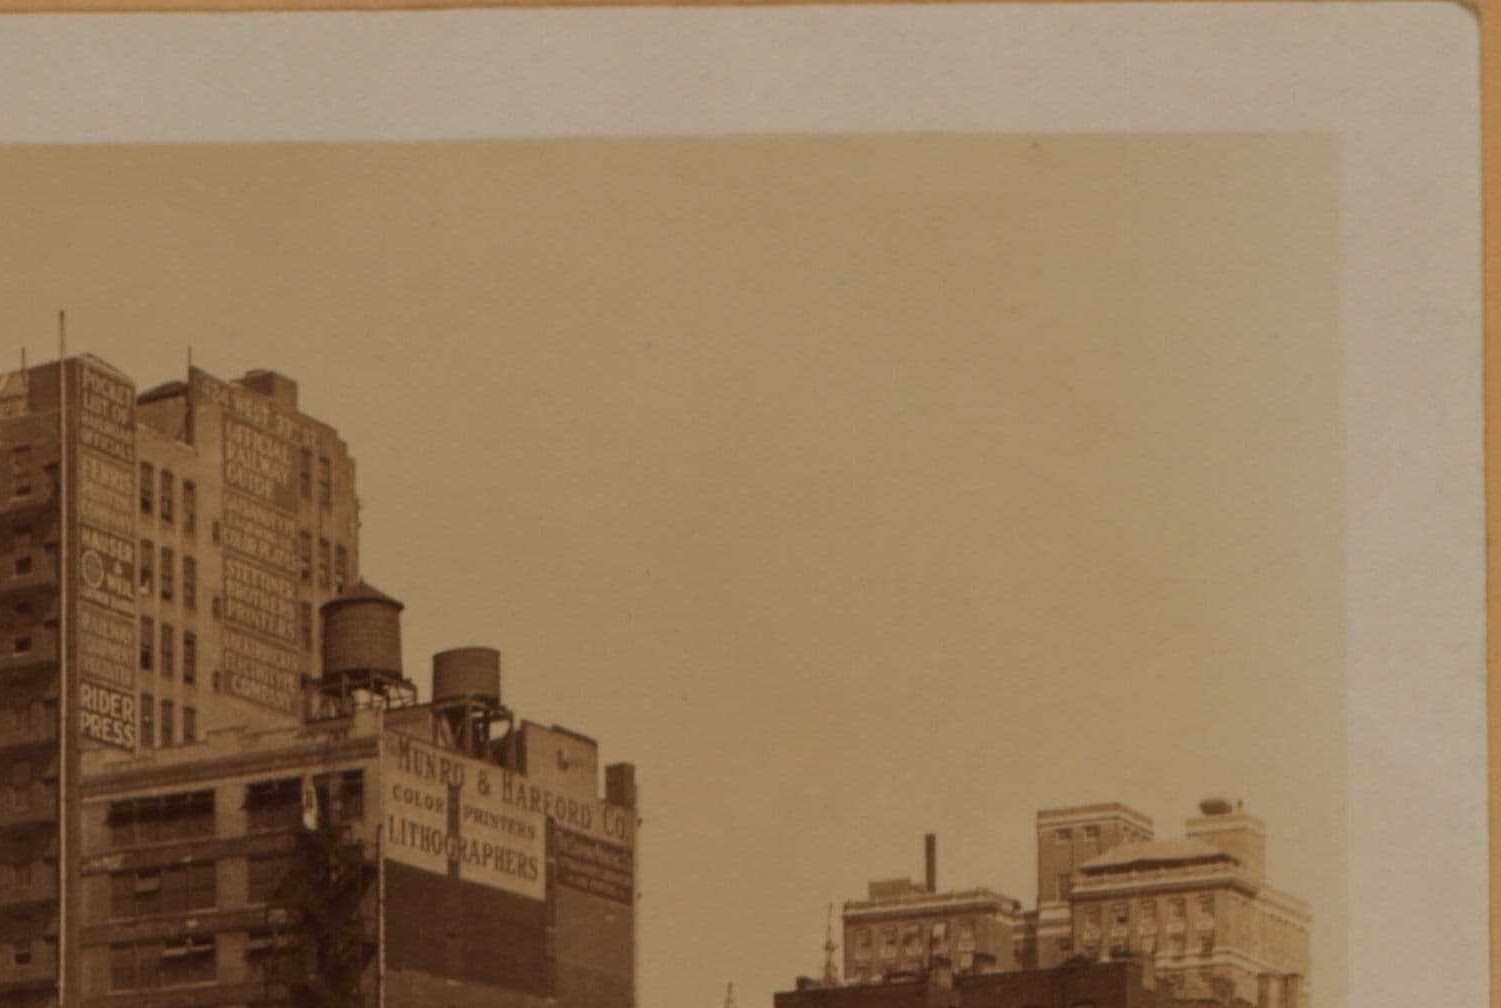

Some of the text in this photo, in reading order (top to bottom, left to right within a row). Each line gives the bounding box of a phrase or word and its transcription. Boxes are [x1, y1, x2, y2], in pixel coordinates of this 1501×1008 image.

[80, 711, 134, 747] PRESS
[81, 684, 134, 722] RIDER
[398, 735, 466, 788] MUNRO
[477, 768, 492, 796] &
[502, 771, 593, 830] HARFORD
[392, 783, 536, 841] COLOR PRINTERS
[387, 814, 540, 883] LITHOGRAPHERS
